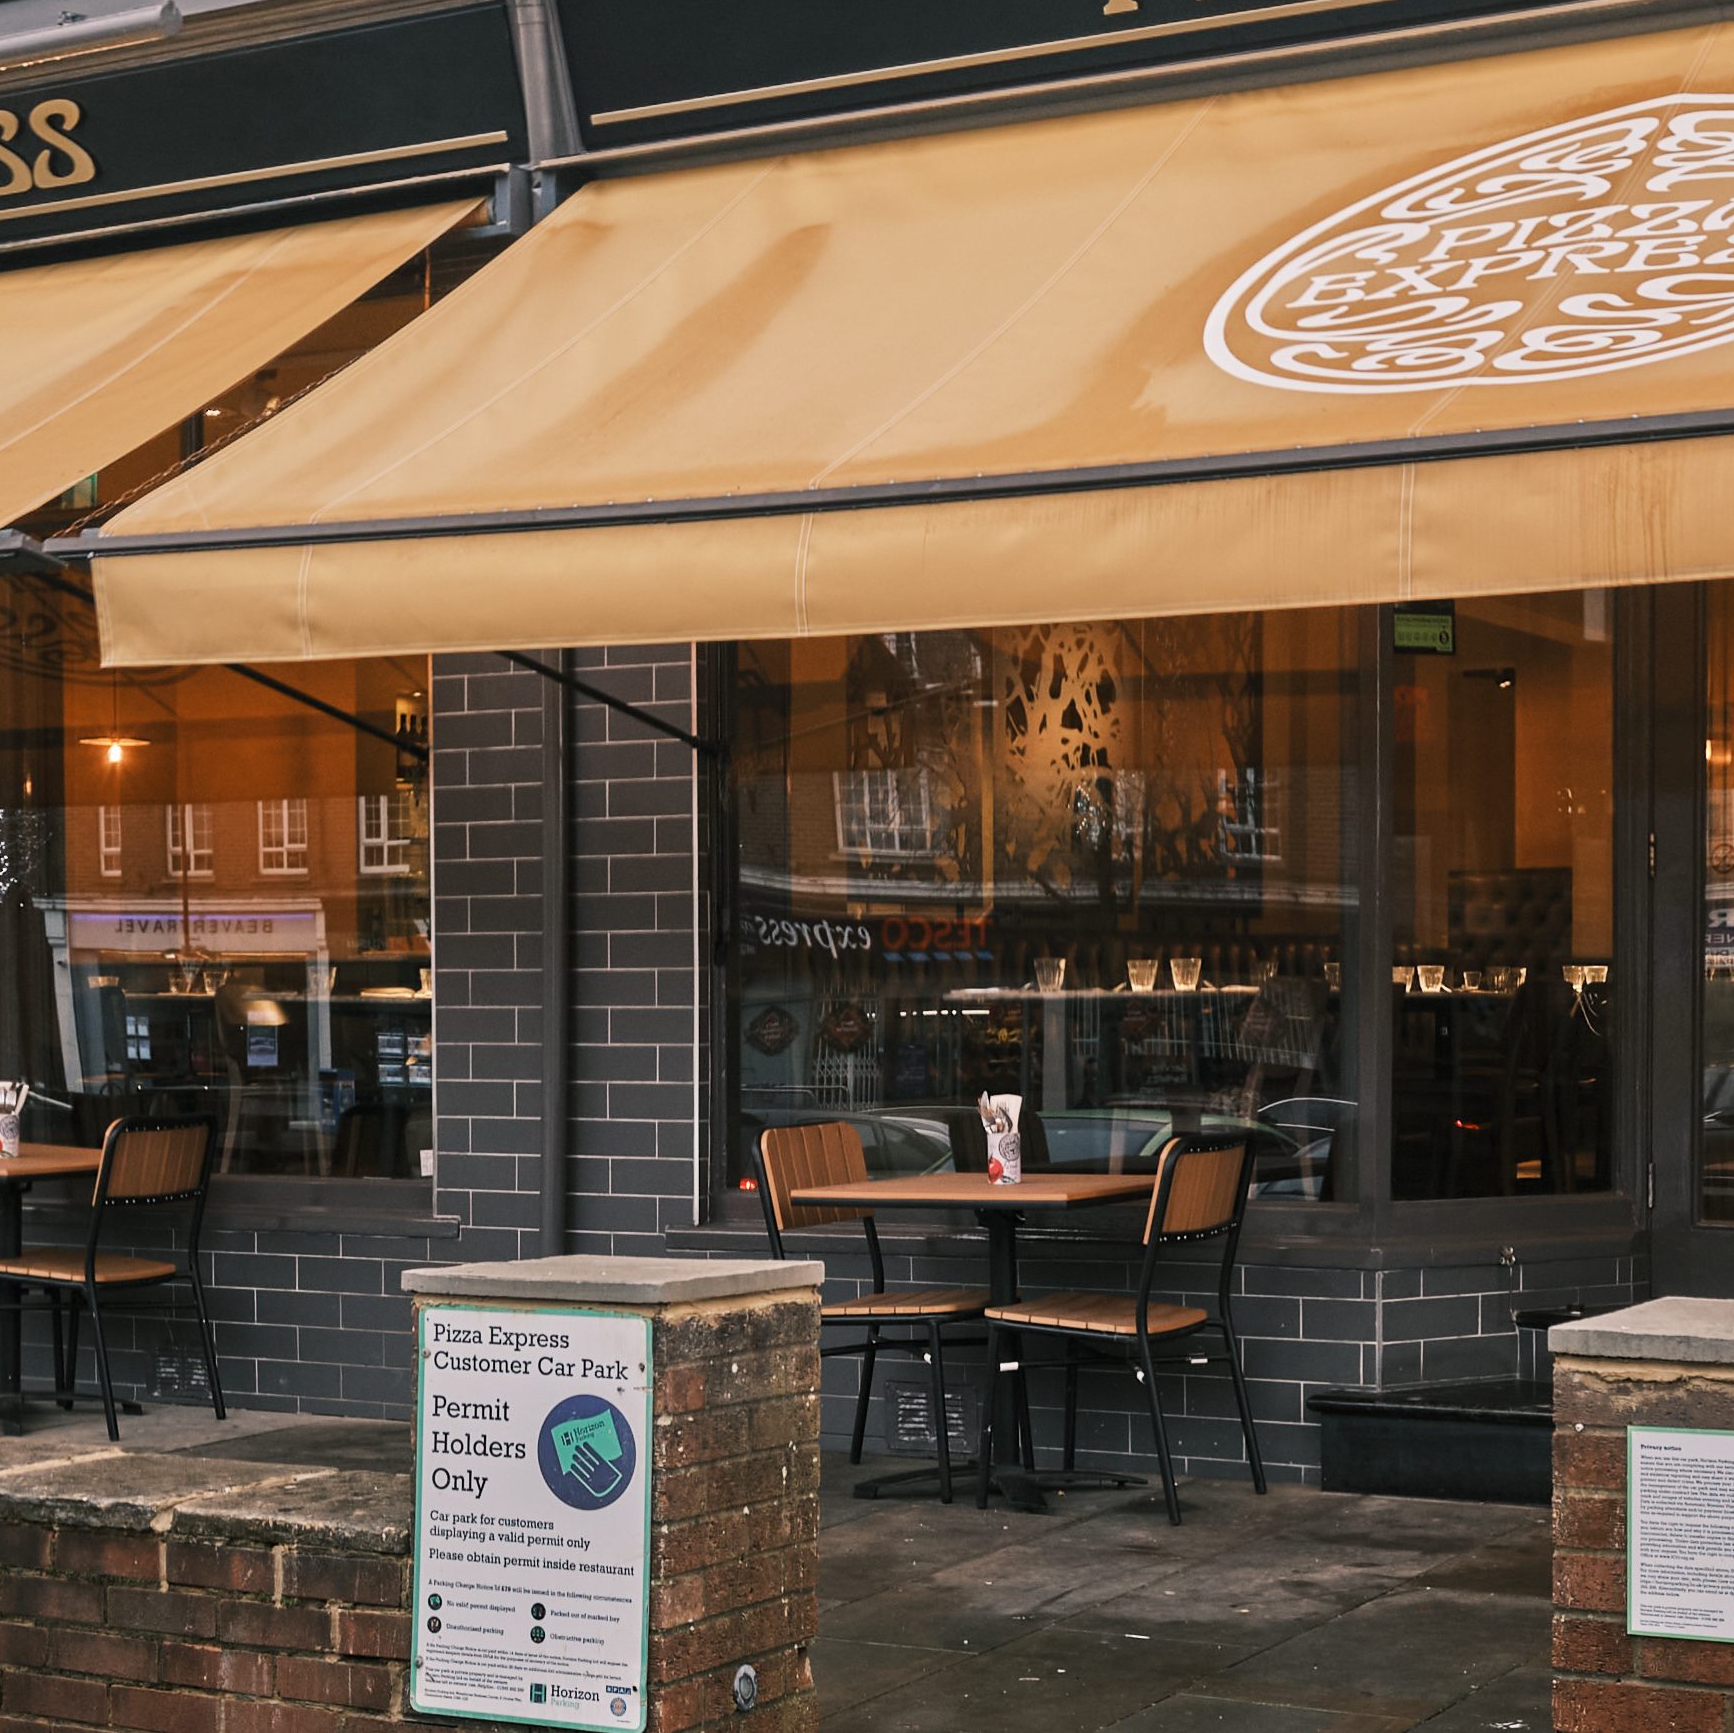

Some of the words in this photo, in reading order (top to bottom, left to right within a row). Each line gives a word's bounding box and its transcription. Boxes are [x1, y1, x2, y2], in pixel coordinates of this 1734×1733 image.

[433, 1323, 483, 1344] Pizza
[489, 1326, 569, 1351] Express
[434, 1351, 531, 1374] Customer
[537, 1356, 575, 1377] Car
[581, 1359, 628, 1380] Park
[432, 1395, 509, 1421] Permit
[573, 1419, 605, 1437] Horizon
[432, 1431, 526, 1459] Holders
[432, 1468, 488, 1499] Only
[430, 1510, 450, 1522] Car
[452, 1512, 477, 1525] park
[480, 1513, 495, 1526] for
[498, 1517, 554, 1530] customers
[429, 1526, 486, 1543] displaying
[488, 1533, 495, 1542] a
[497, 1530, 525, 1544] valid
[527, 1534, 564, 1547] permit
[567, 1536, 590, 1551] only
[429, 1548, 464, 1561] Please
[466, 1551, 501, 1565] obtain
[503, 1554, 540, 1568] permit
[542, 1557, 576, 1571] inside
[579, 1561, 634, 1576] restaurant
[550, 1684, 600, 1702] Horizon
[550, 1698, 580, 1709] Parking
